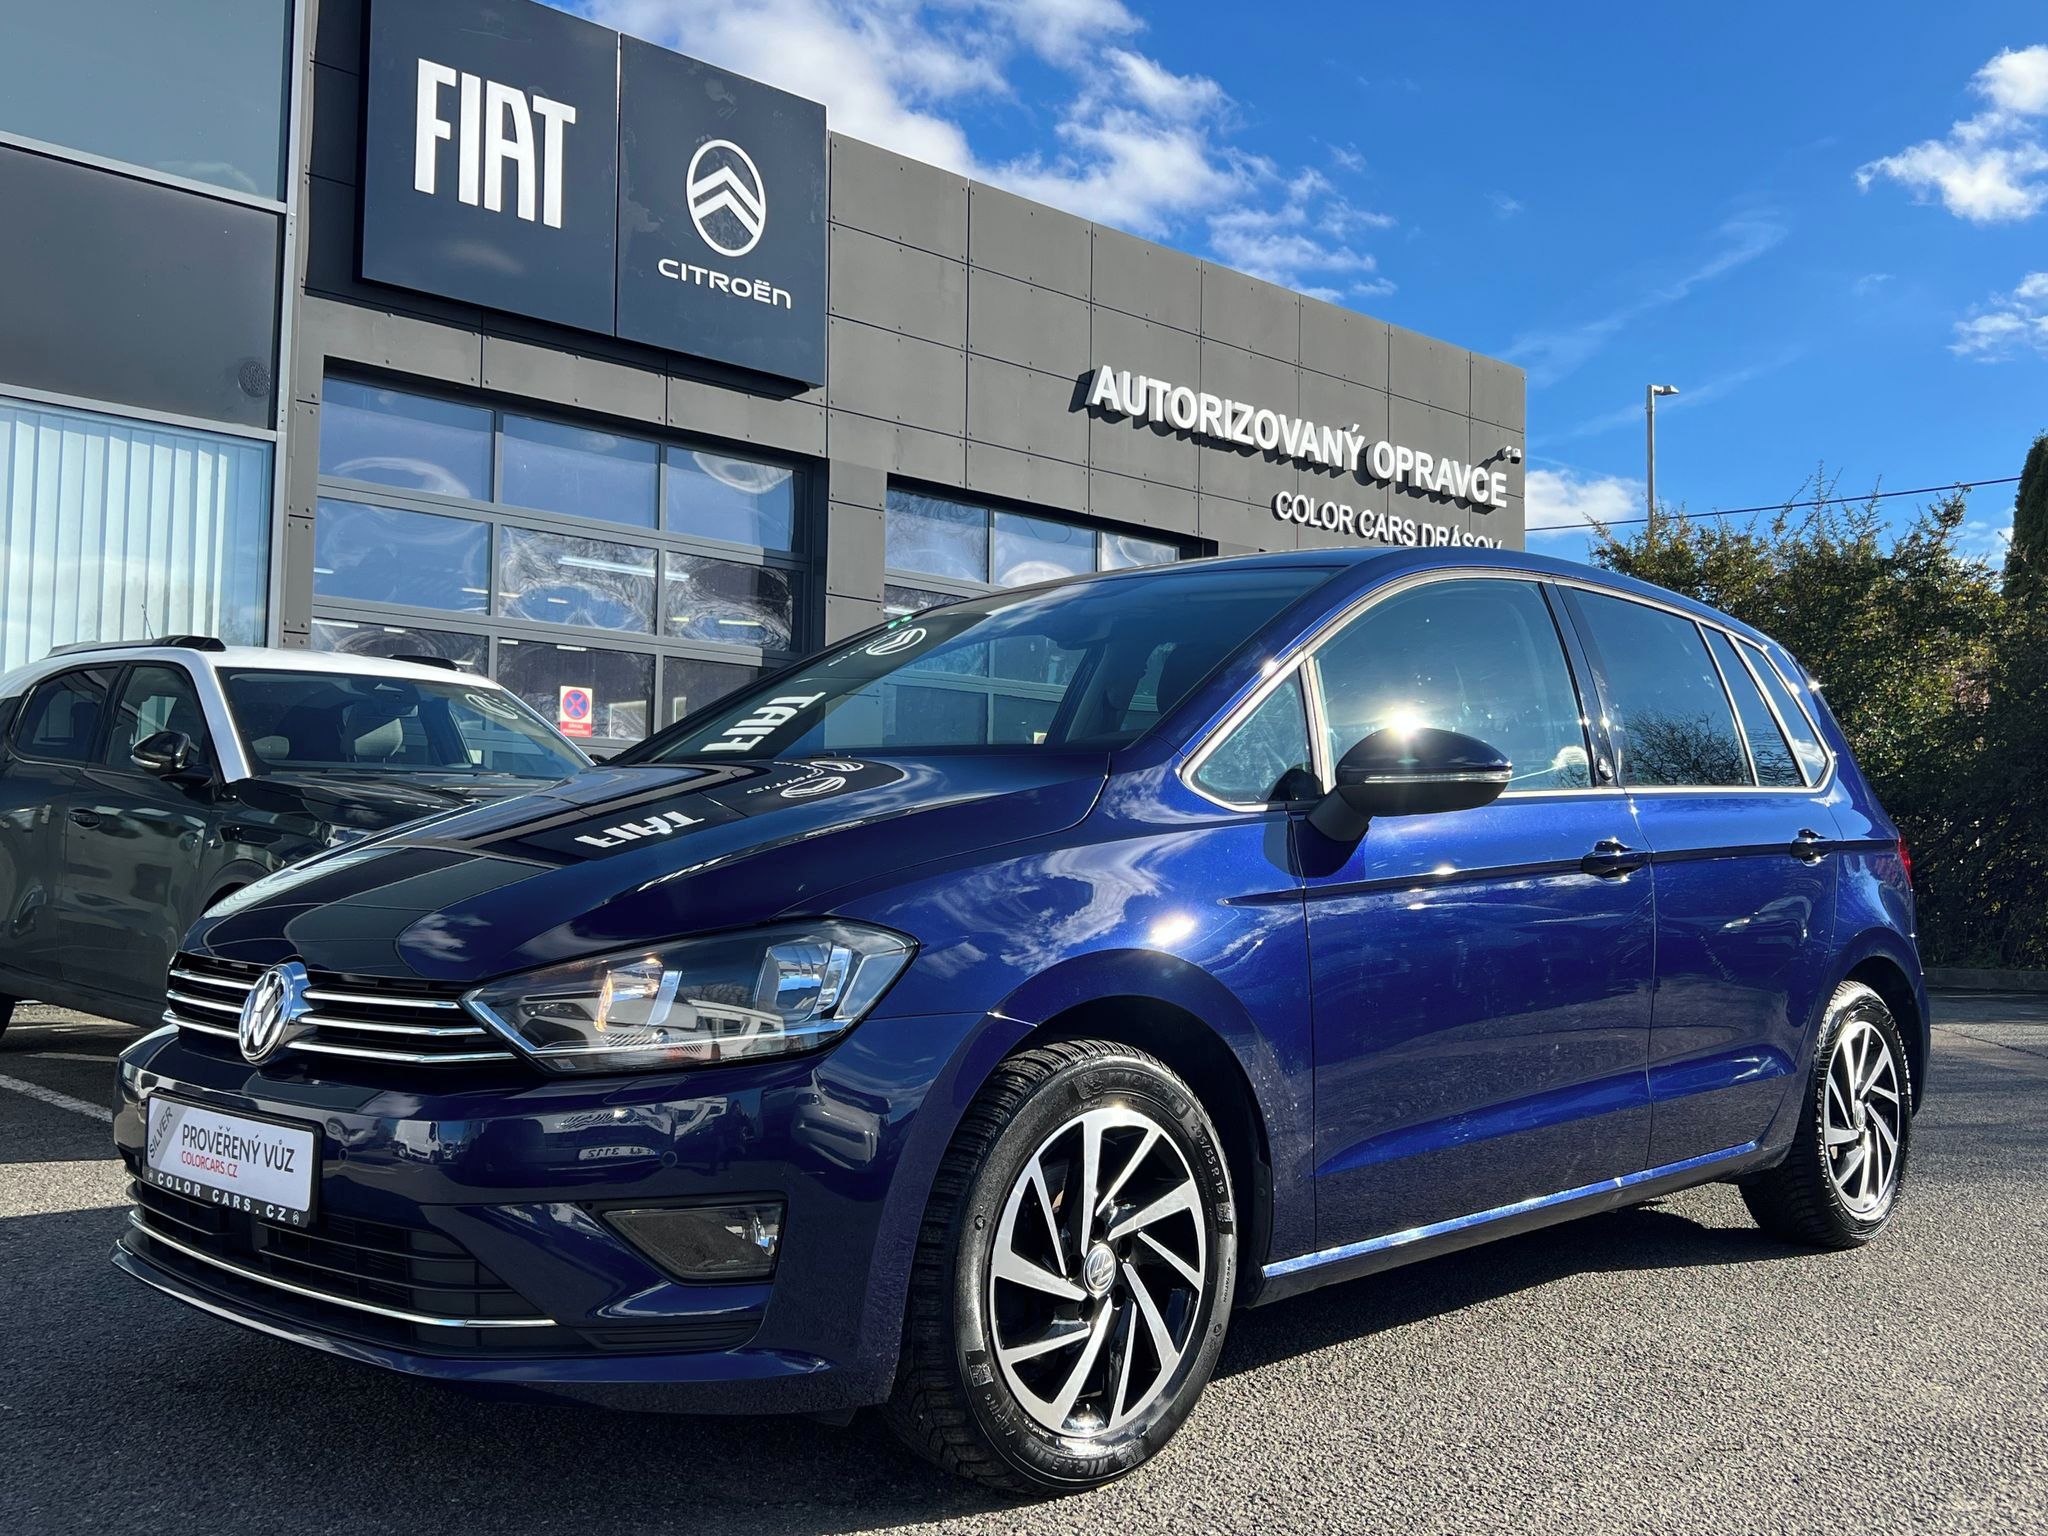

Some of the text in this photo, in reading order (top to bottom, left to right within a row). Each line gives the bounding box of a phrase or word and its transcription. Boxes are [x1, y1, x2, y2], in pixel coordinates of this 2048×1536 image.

[414, 58, 576, 229] FIAT
[1090, 364, 1508, 508] AUTORIZOVANÝ OPRAVCE
[1275, 490, 1354, 534] COLOR
[1358, 509, 1417, 547] CARS
[149, 1106, 174, 1159] SILVER
[181, 1124, 295, 1173] PROVĚŘENÝ VŮZ
[157, 1172, 201, 1197] COLOR
[181, 1150, 238, 1178] COLORCARS.CZ
